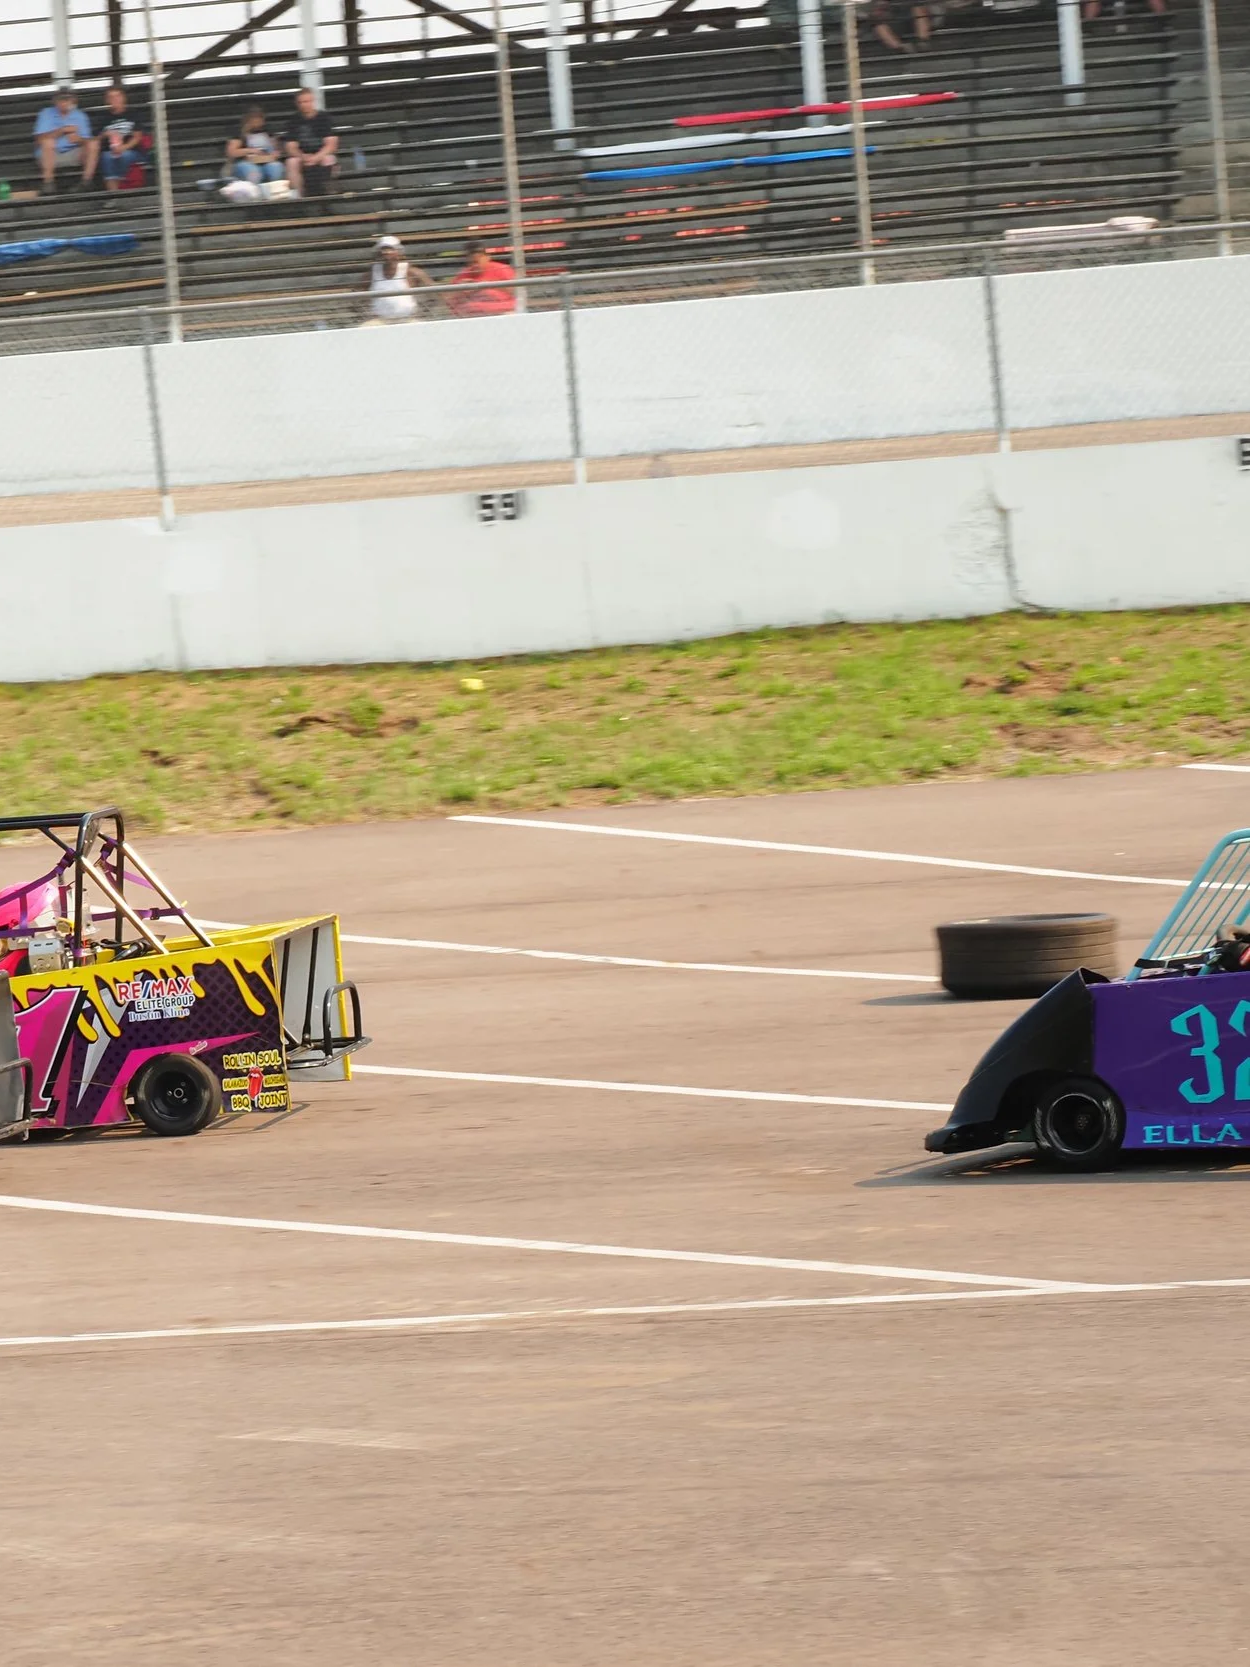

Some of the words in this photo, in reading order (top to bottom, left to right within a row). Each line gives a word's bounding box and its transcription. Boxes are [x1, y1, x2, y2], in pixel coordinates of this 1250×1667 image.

[475, 491, 525, 524] 59
[116, 976, 195, 1001] RE/MAX
[135, 999, 164, 1011] ELITE
[164, 995, 196, 1008] GROUP
[257, 1049, 282, 1066] SOUL
[231, 1094, 252, 1112] BBQ
[258, 1091, 287, 1109] JOINT
[1143, 1123, 1243, 1144] ELLA
